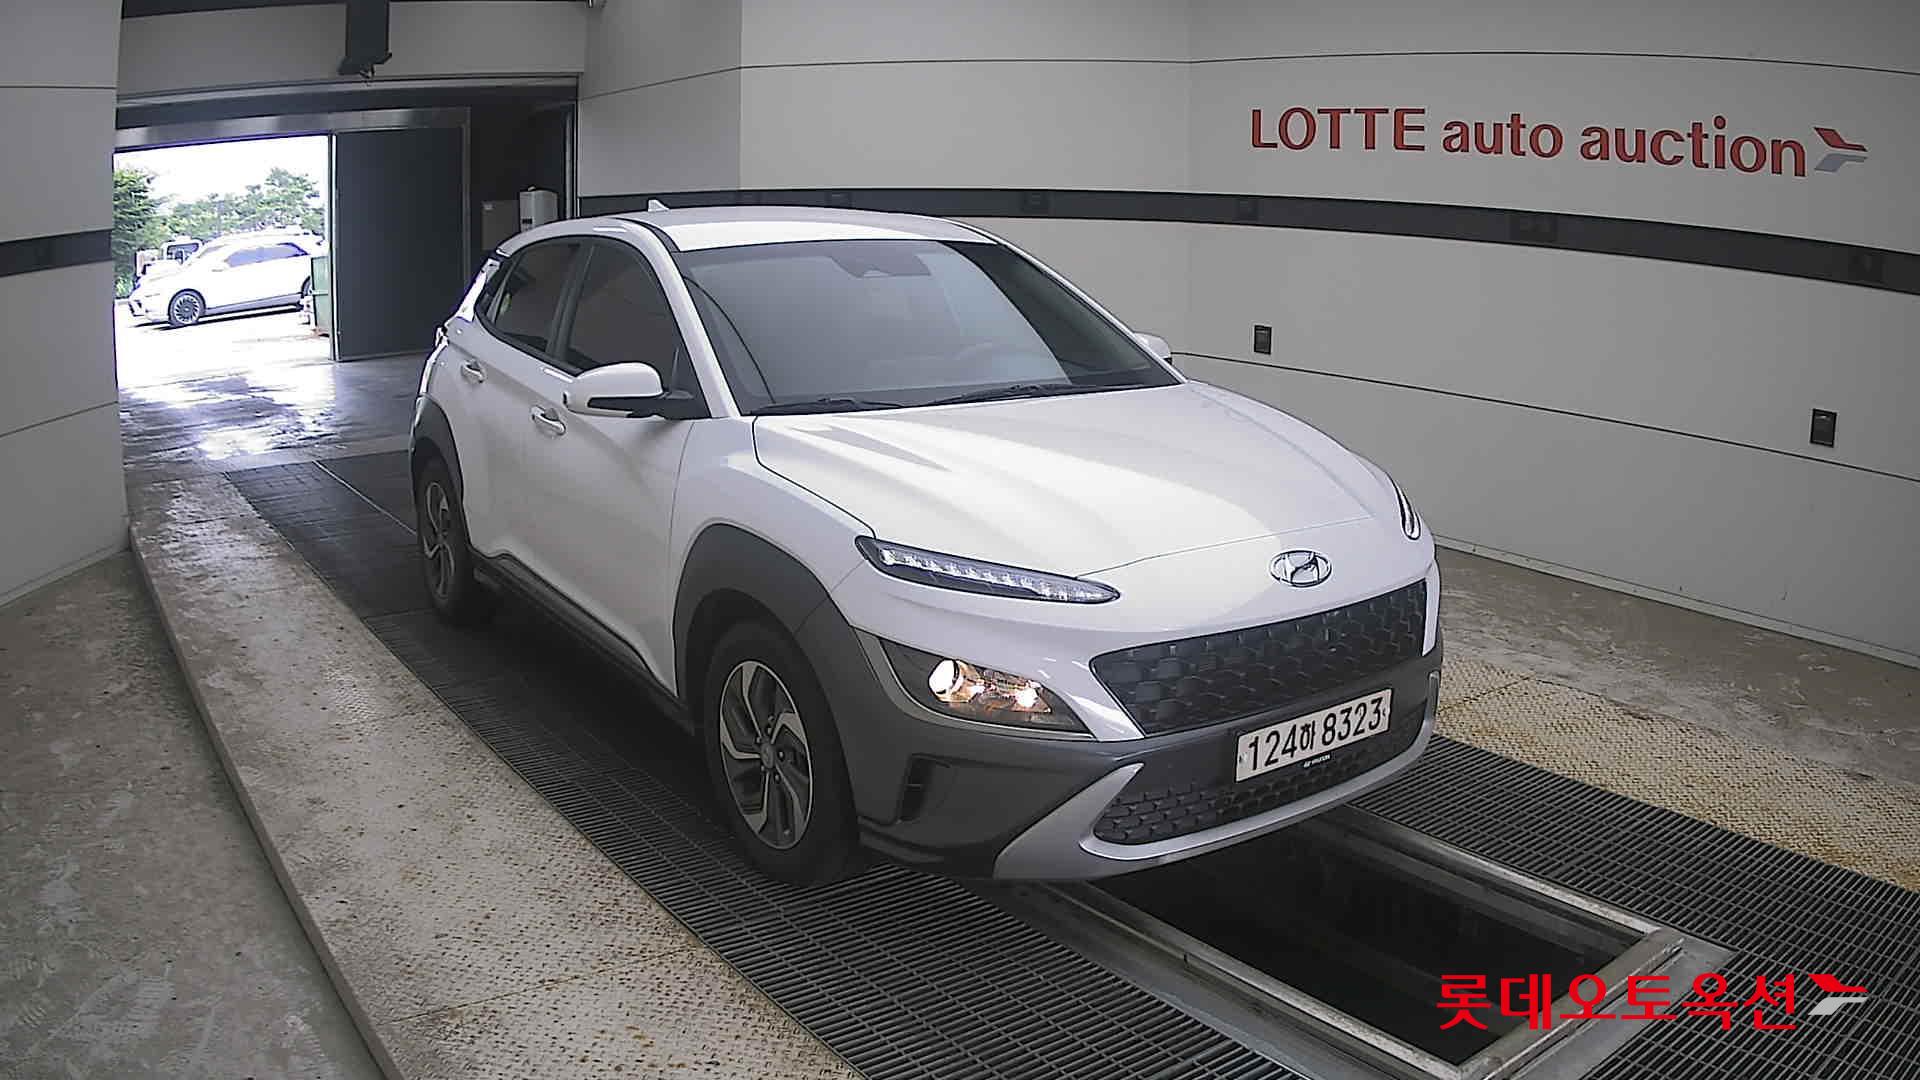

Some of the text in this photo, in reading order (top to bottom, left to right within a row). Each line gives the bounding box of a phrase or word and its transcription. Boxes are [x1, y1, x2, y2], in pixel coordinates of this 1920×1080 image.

[1251, 107, 1806, 177] LOTTE auto auction
[1321, 697, 1383, 746] 8323
